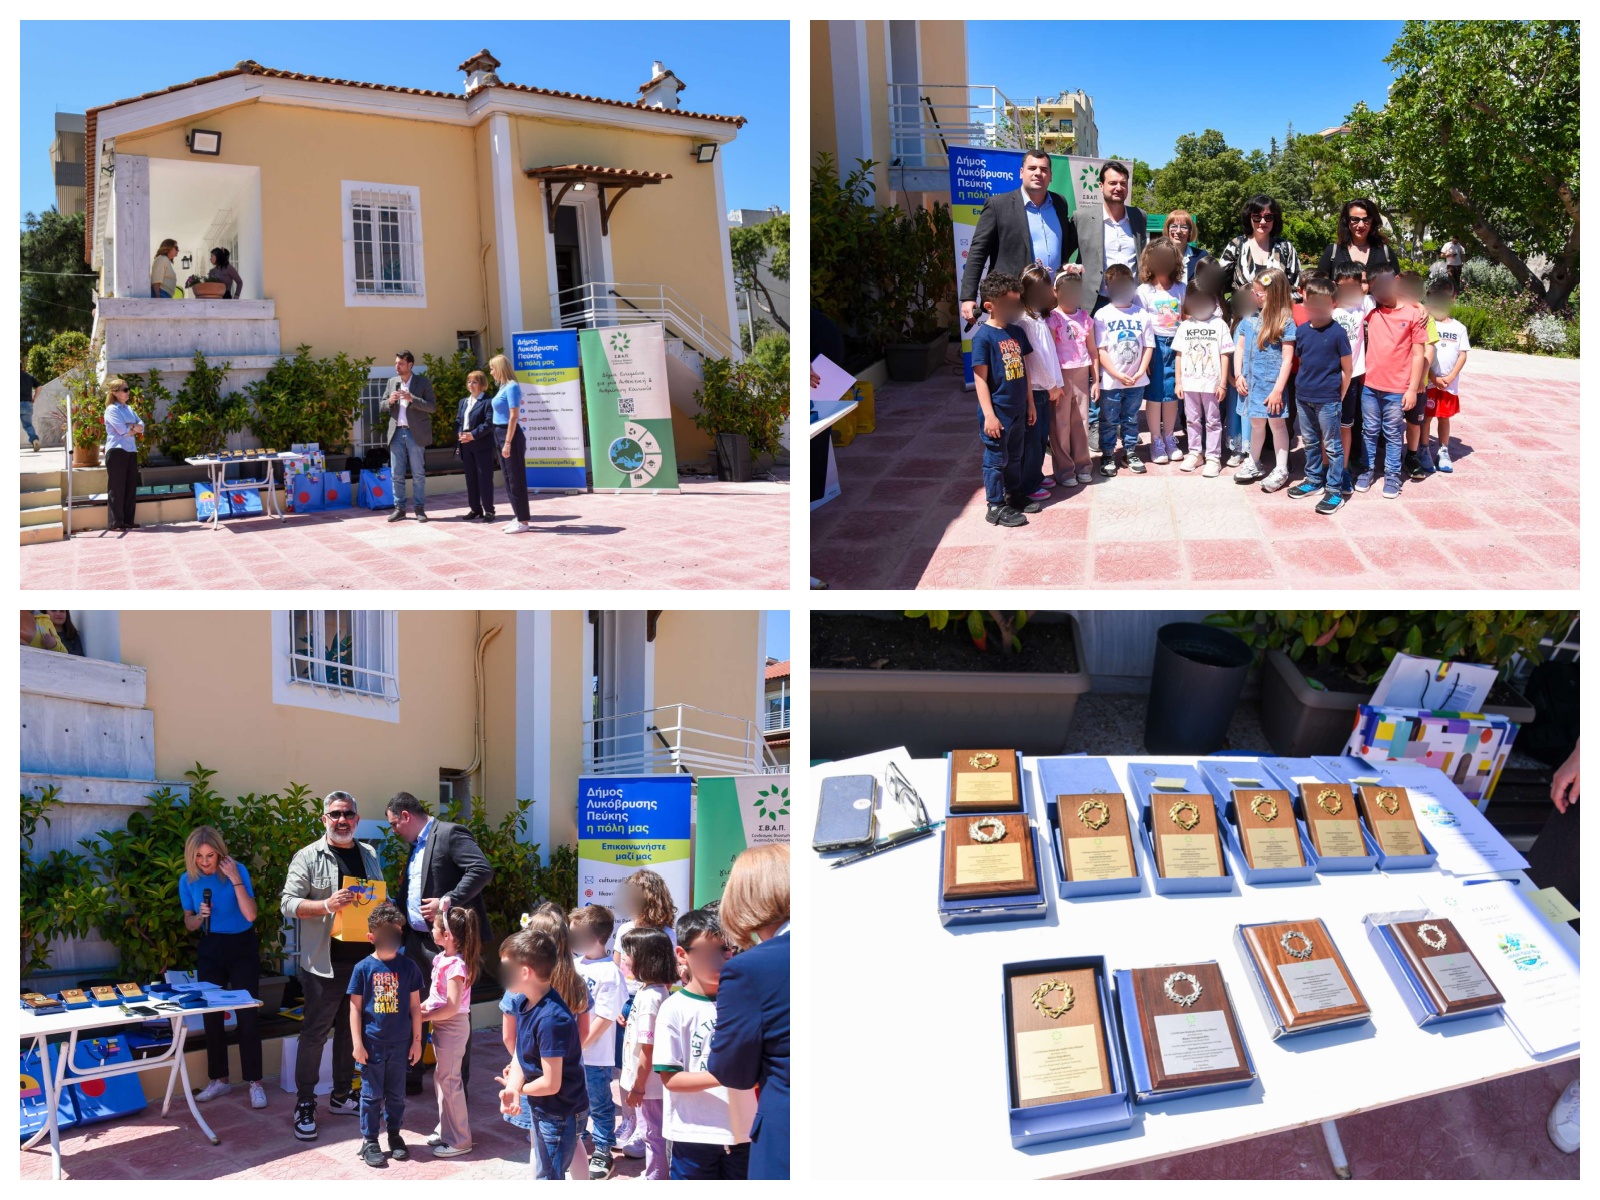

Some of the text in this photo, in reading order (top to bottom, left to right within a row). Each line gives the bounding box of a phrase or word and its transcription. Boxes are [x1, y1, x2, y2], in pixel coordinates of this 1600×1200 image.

[956, 156, 986, 168] Δήμος
[956, 167, 1014, 181] Λυκόβρυσης
[957, 178, 993, 190] Πεύκης
[1437, 331, 1458, 340] ARIS
[586, 787, 623, 798] Δήμος
[586, 798, 658, 810] Λυκόβρυσης
[587, 811, 629, 822] Πεύκης
[586, 823, 650, 834] η πόλη μας
[601, 842, 667, 851] Επικοινωνήστε
[615, 851, 652, 861] μαζί μας
